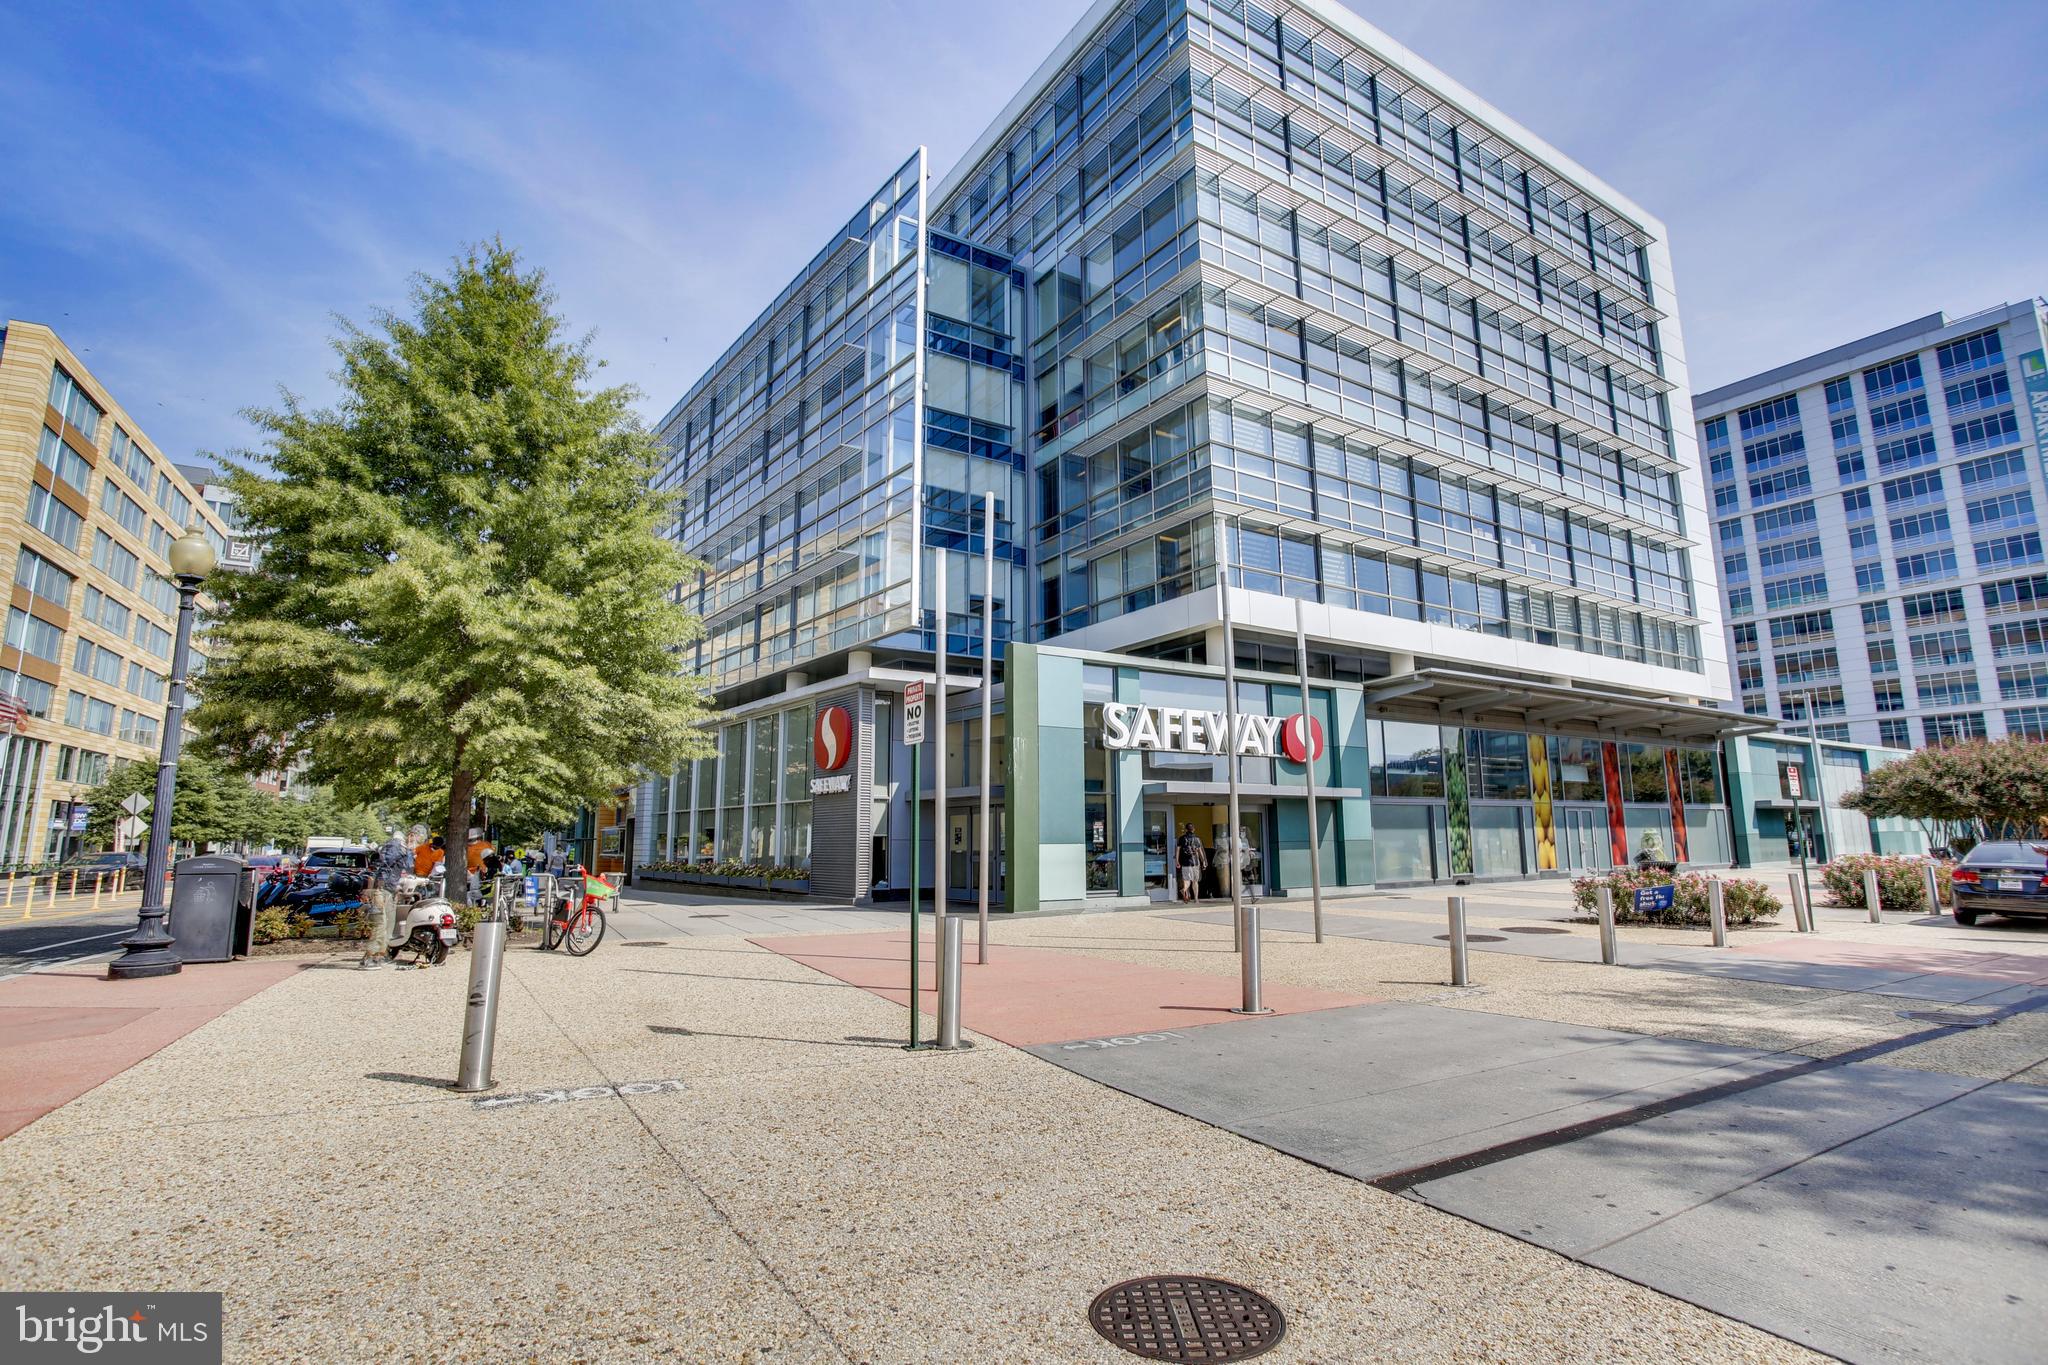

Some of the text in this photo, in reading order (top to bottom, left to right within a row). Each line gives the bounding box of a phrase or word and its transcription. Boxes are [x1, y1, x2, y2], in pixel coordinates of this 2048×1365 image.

[907, 705, 921, 720] NO
[1103, 702, 1282, 756] SAFEWAY
[810, 775, 851, 794] SAFEWAY
